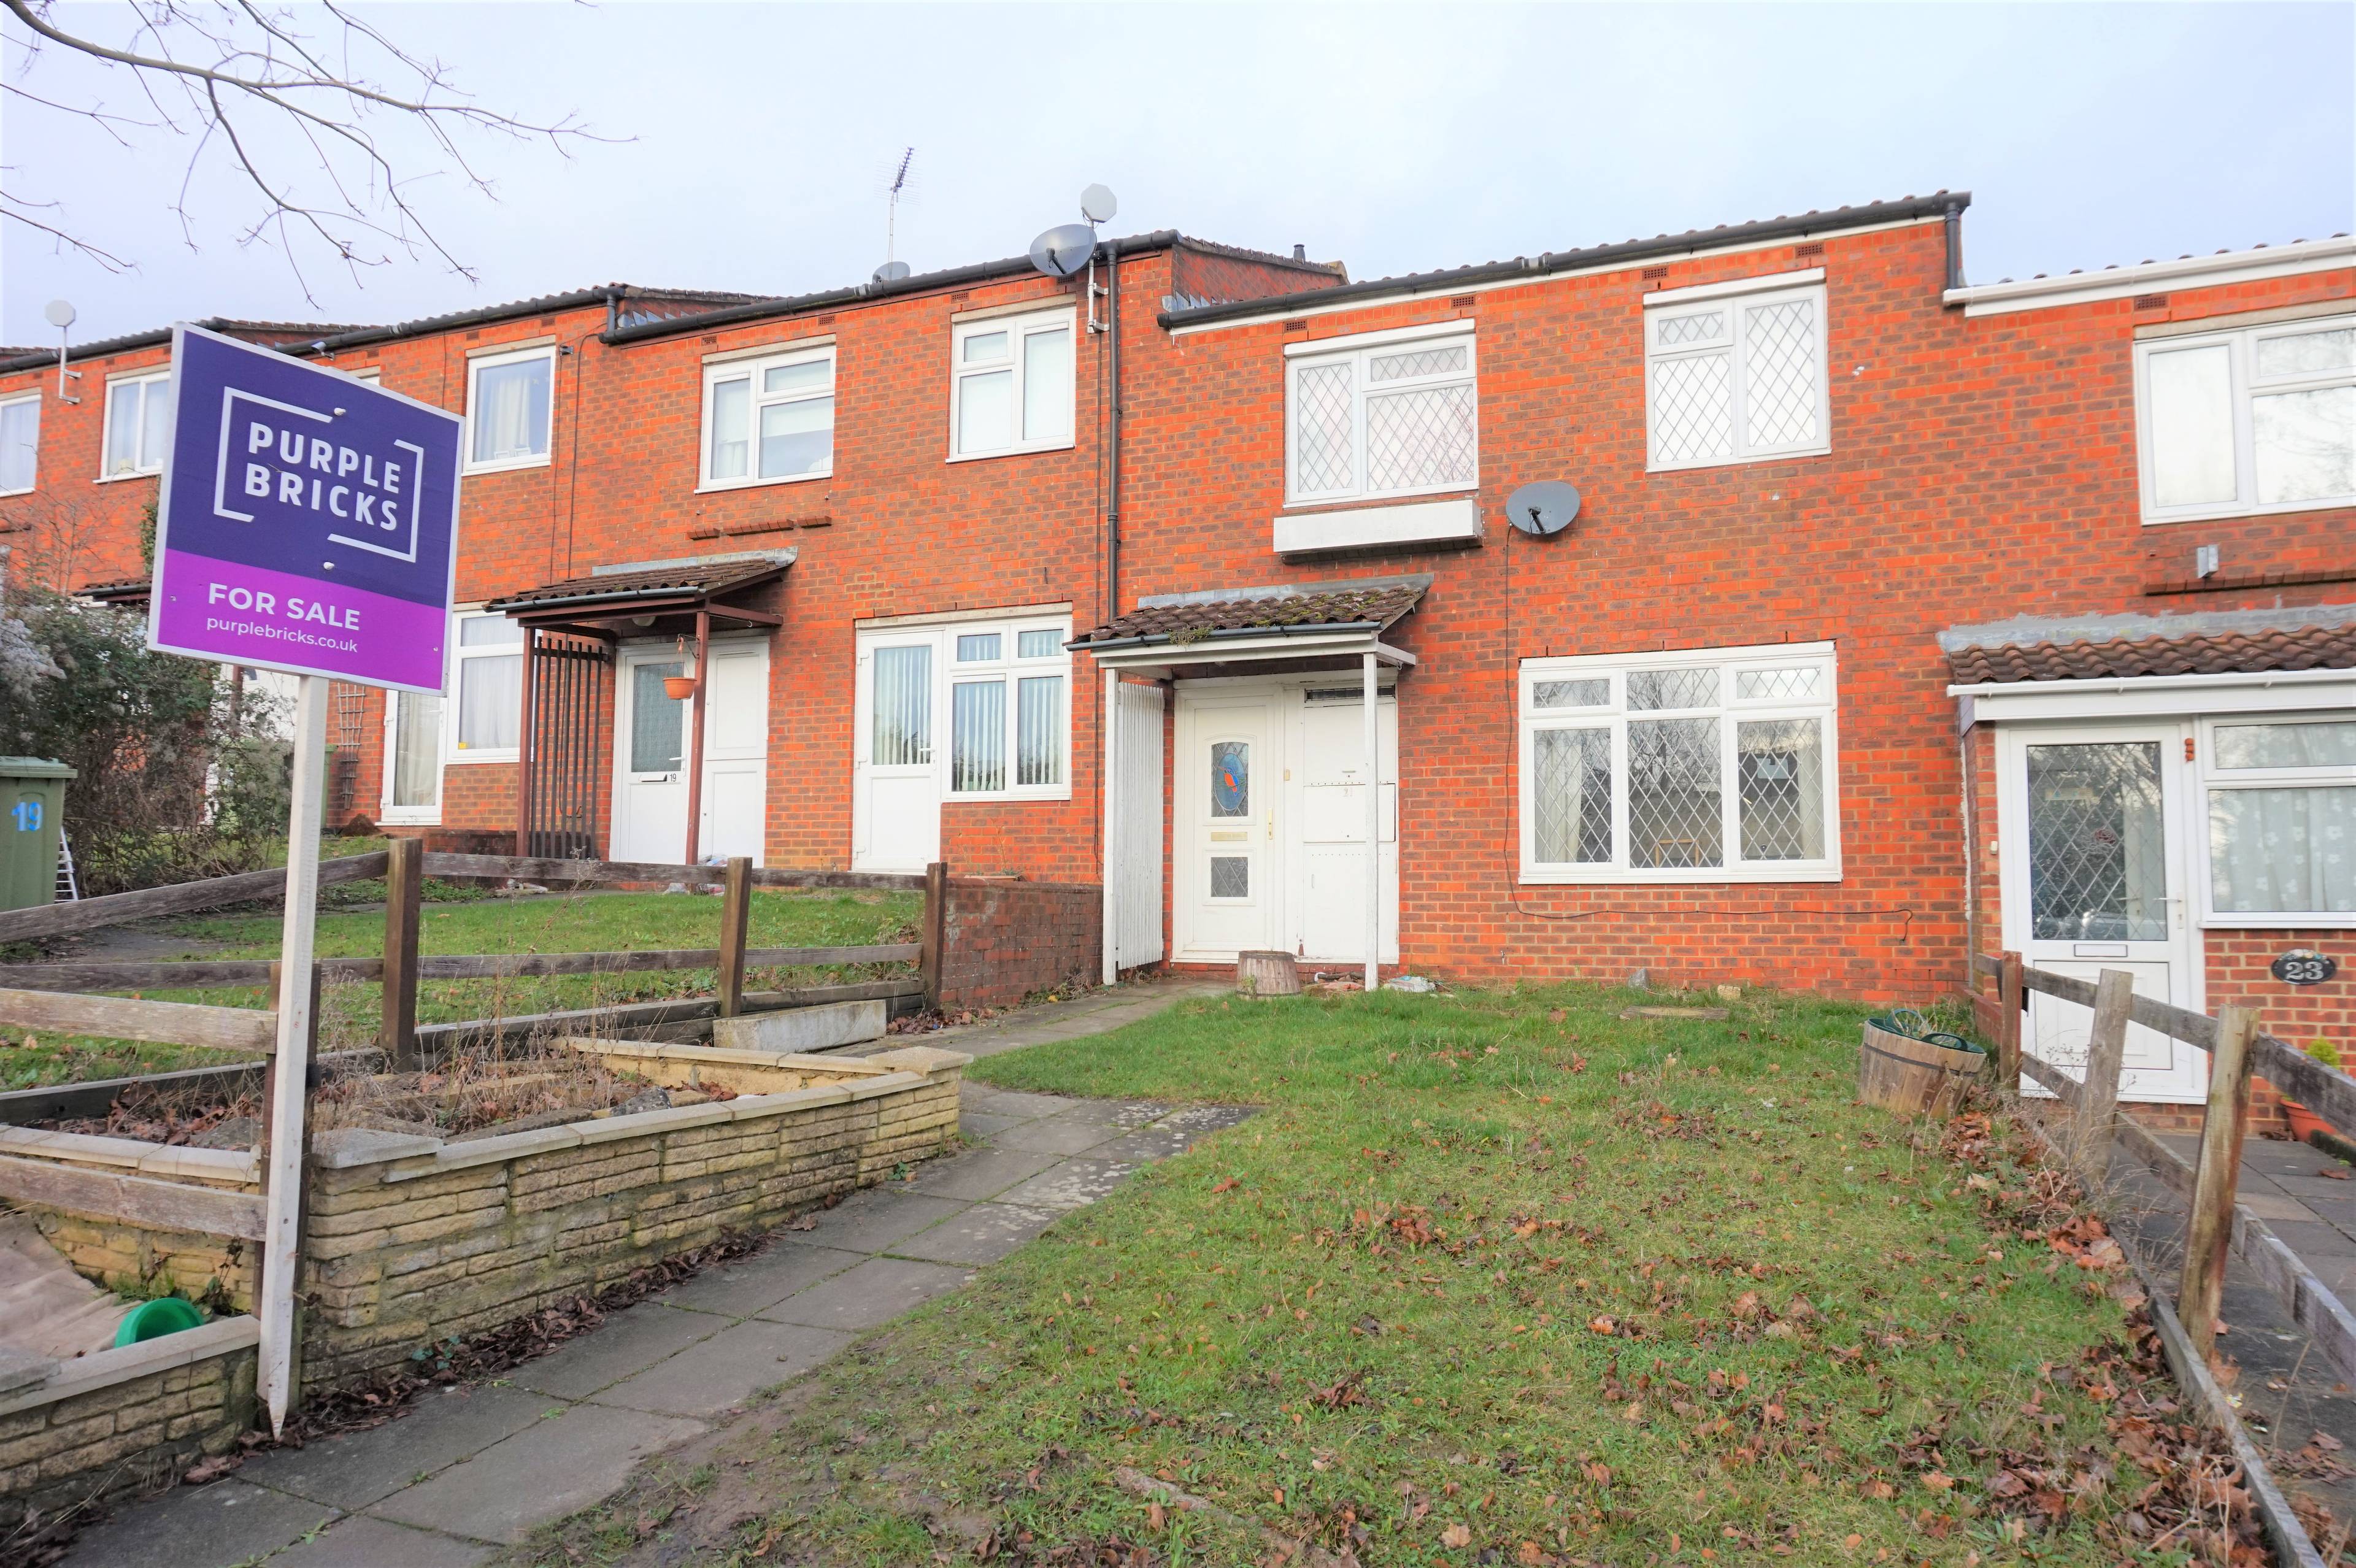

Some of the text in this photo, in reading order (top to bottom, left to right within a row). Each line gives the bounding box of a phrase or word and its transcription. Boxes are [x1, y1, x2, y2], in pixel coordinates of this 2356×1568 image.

[248, 421, 401, 494] PURPLE
[244, 462, 399, 531] BRICKS
[208, 582, 361, 631] FOR SALE
[206, 616, 358, 653] purplebricks.co.uk
[669, 773, 677, 782] 19
[12, 802, 42, 831] 19
[2284, 961, 2324, 980] 23
